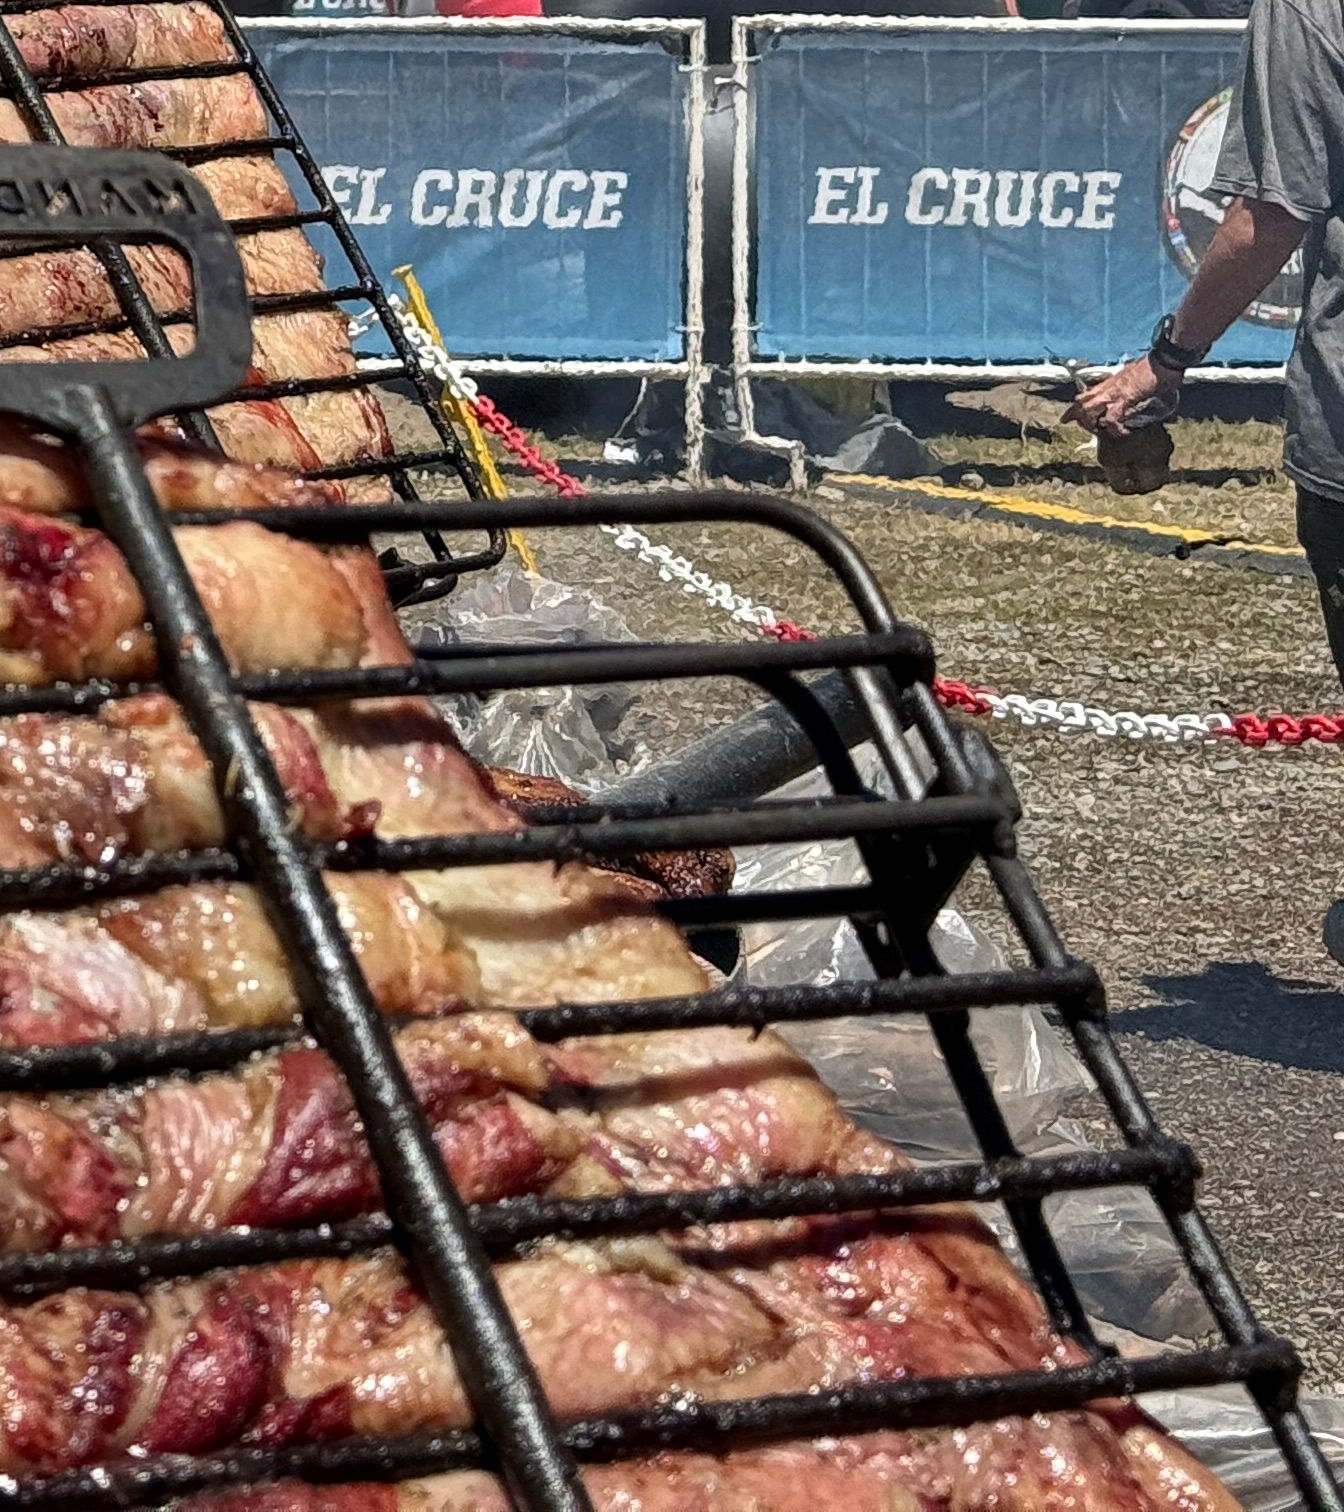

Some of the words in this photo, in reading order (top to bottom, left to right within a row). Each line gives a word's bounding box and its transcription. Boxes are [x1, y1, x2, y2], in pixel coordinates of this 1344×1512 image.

[319, 164, 393, 226] EL
[410, 167, 629, 229] CRUCE
[807, 166, 889, 226] EL
[904, 167, 1123, 230] CRUCE
